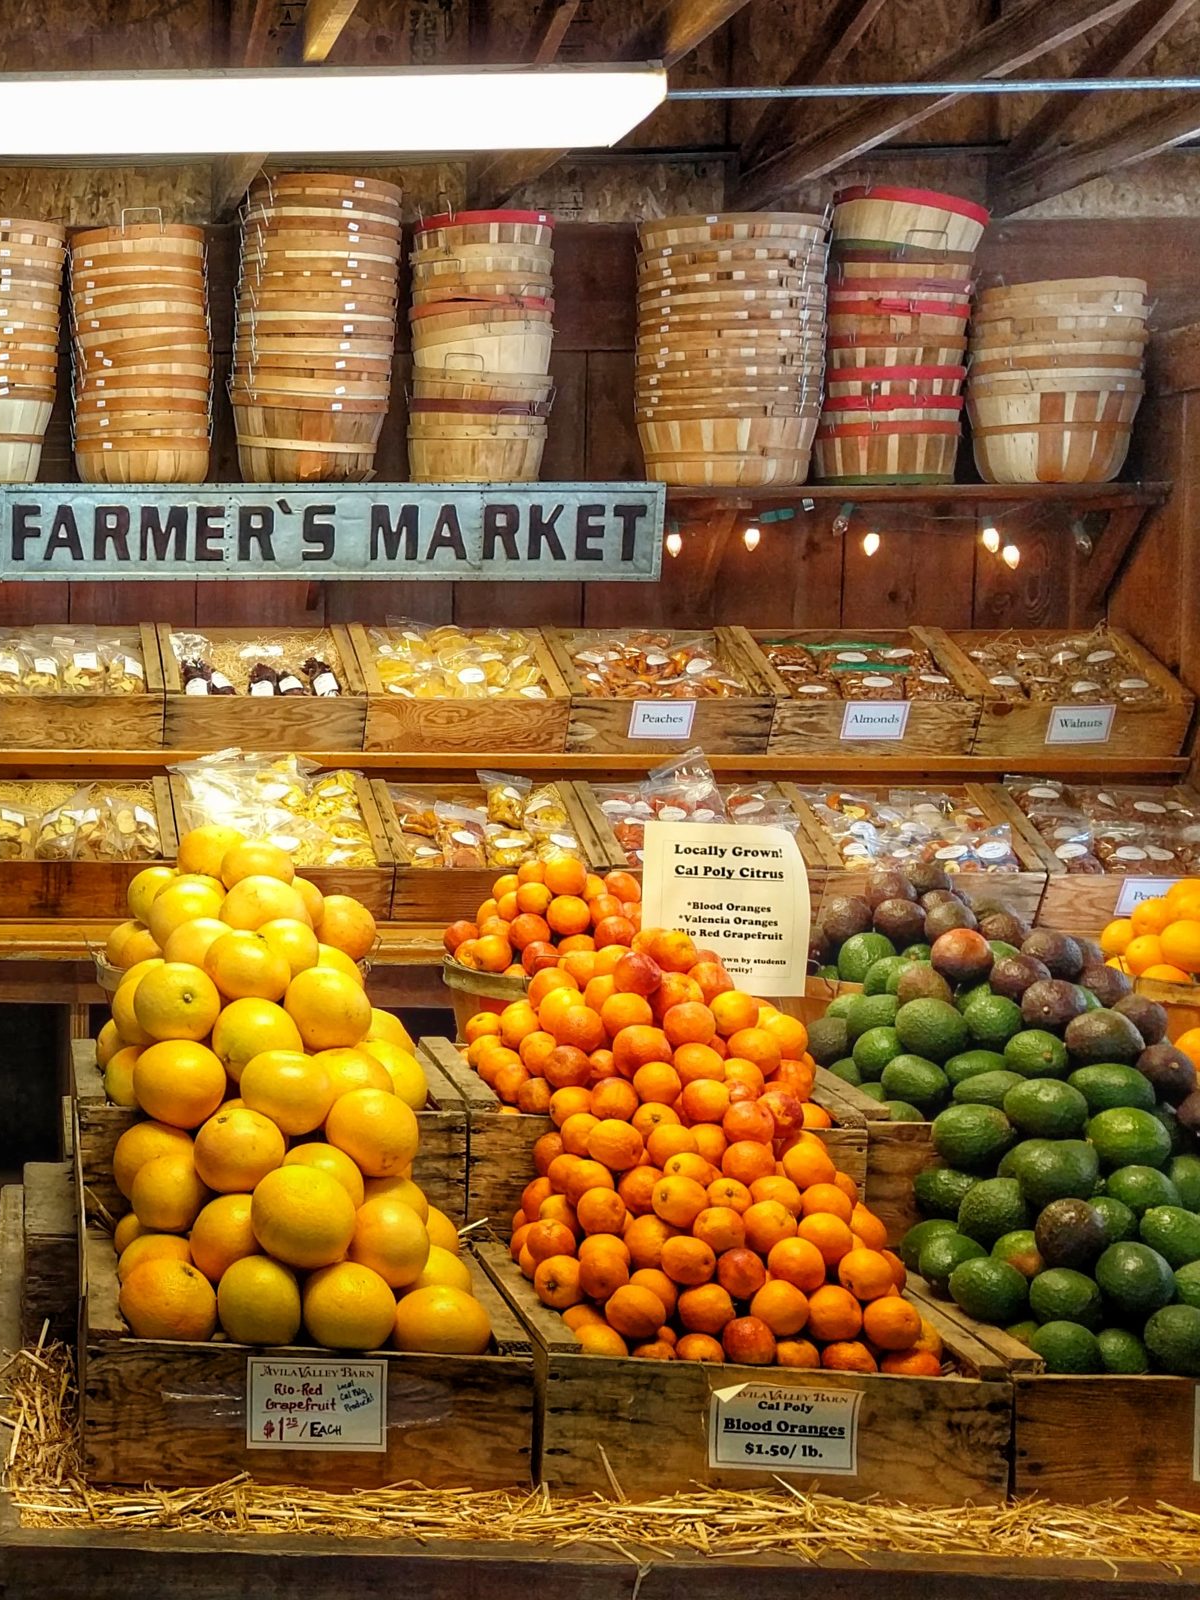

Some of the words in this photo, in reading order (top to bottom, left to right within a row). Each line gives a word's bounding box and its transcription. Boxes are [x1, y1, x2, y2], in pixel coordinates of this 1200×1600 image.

[10, 497, 337, 562] FARMER'S
[370, 503, 649, 562] MARKET
[641, 713, 684, 724] Peaches
[850, 713, 900, 724] Almonds
[1059, 718, 1103, 728] Walnuts
[674, 844, 728, 858] Locally
[732, 846, 783, 858] Grown!
[674, 864, 699, 876] Cal
[703, 866, 735, 879] Poly
[739, 867, 784, 880] Citrus
[726, 903, 772, 913] Oranges
[734, 916, 778, 927] Oranges
[699, 928, 720, 938] Red
[723, 930, 783, 942] Grapefruit
[741, 956, 751, 964] by
[753, 957, 787, 966] students
[260, 1365, 297, 1378] AVILA
[298, 1366, 338, 1379] VALLEY
[340, 1367, 375, 1379] BARN
[768, 1390, 811, 1402] VALLEY
[813, 1391, 849, 1404] BARN
[266, 1397, 337, 1414] Grapefruit
[758, 1401, 780, 1411] Cal
[783, 1402, 814, 1414] Poly
[723, 1417, 773, 1432] Blood
[776, 1420, 846, 1438] Oranges
[801, 1444, 823, 1458] lb.
